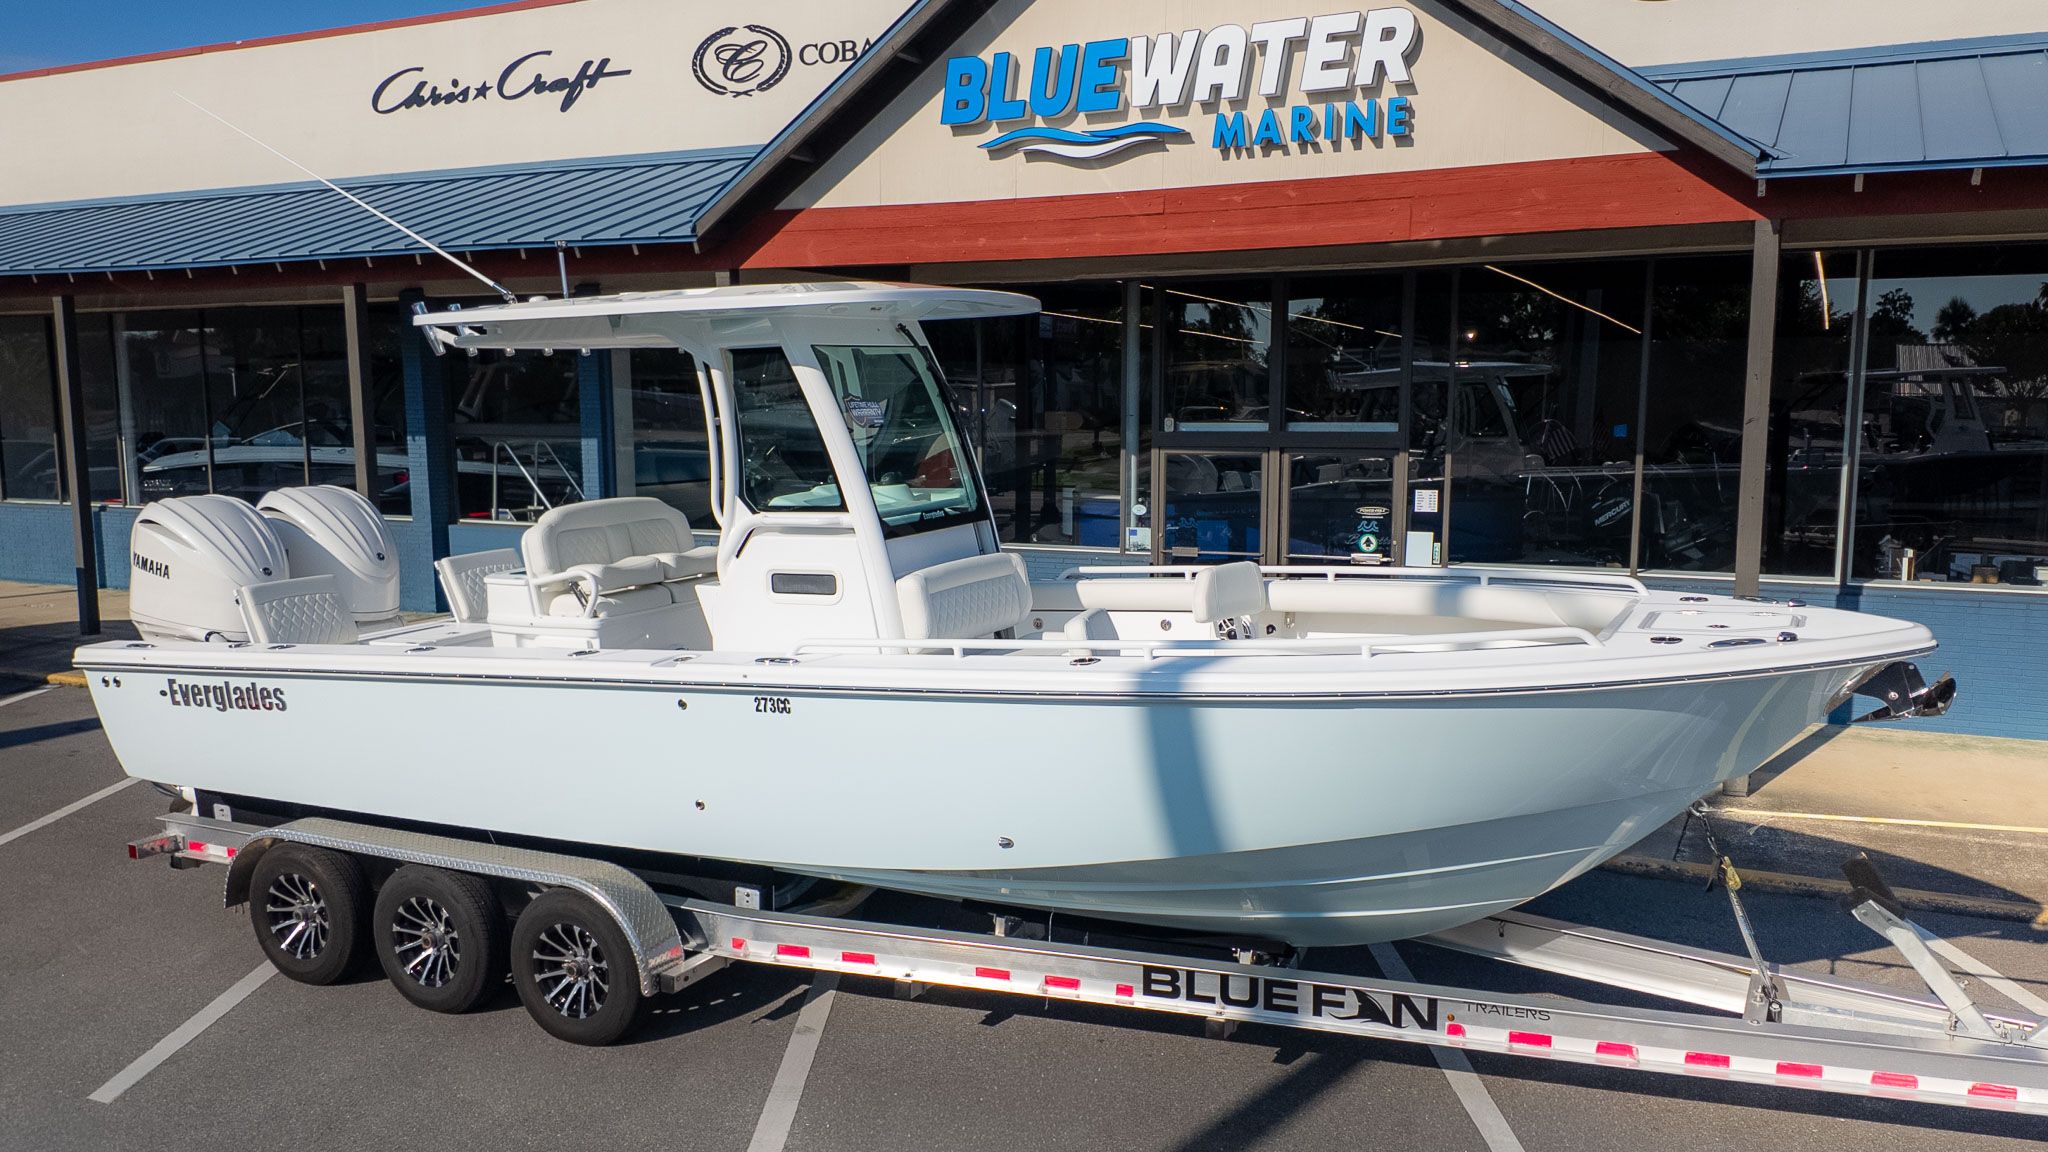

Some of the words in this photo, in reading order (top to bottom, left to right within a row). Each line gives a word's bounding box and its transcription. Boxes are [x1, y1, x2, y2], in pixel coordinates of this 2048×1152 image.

[941, 7, 1414, 125] BLUEWATER
[372, 67, 471, 114] Chris
[497, 50, 632, 113] Craft
[1212, 97, 1408, 149] MARINE
[1594, 500, 1631, 526] MERCURY
[132, 552, 170, 579] YAMAHA
[167, 679, 288, 712] Everglades
[754, 696, 791, 714] 273CC
[1463, 1001, 1551, 1021] TRAILERS
